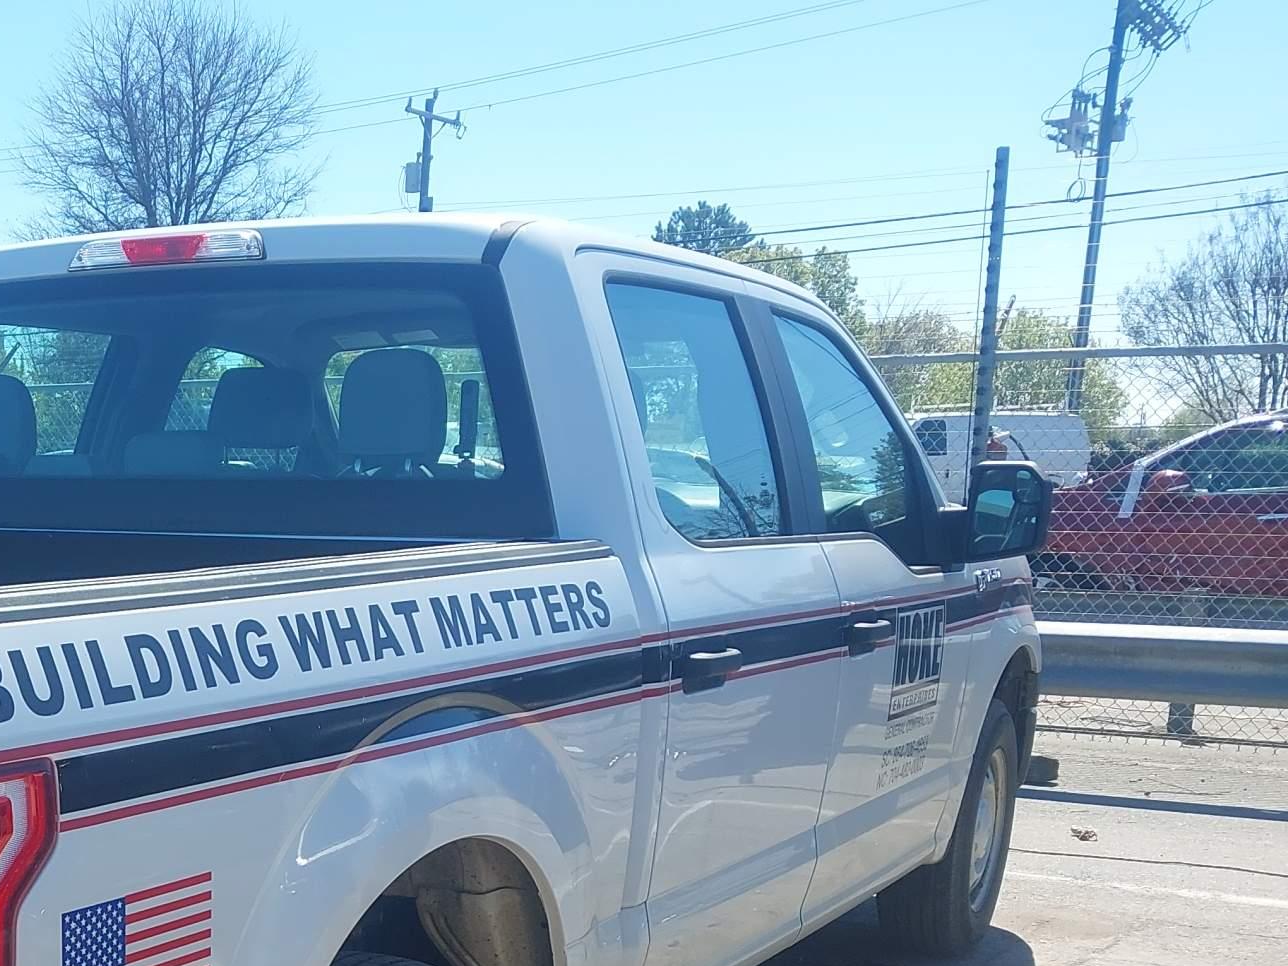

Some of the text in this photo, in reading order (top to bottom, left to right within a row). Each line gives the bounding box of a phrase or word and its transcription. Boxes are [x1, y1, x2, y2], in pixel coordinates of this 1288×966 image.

[278, 599, 420, 672] WHAT
[429, 581, 612, 649] MATTERS
[895, 607, 944, 686] HOKE
